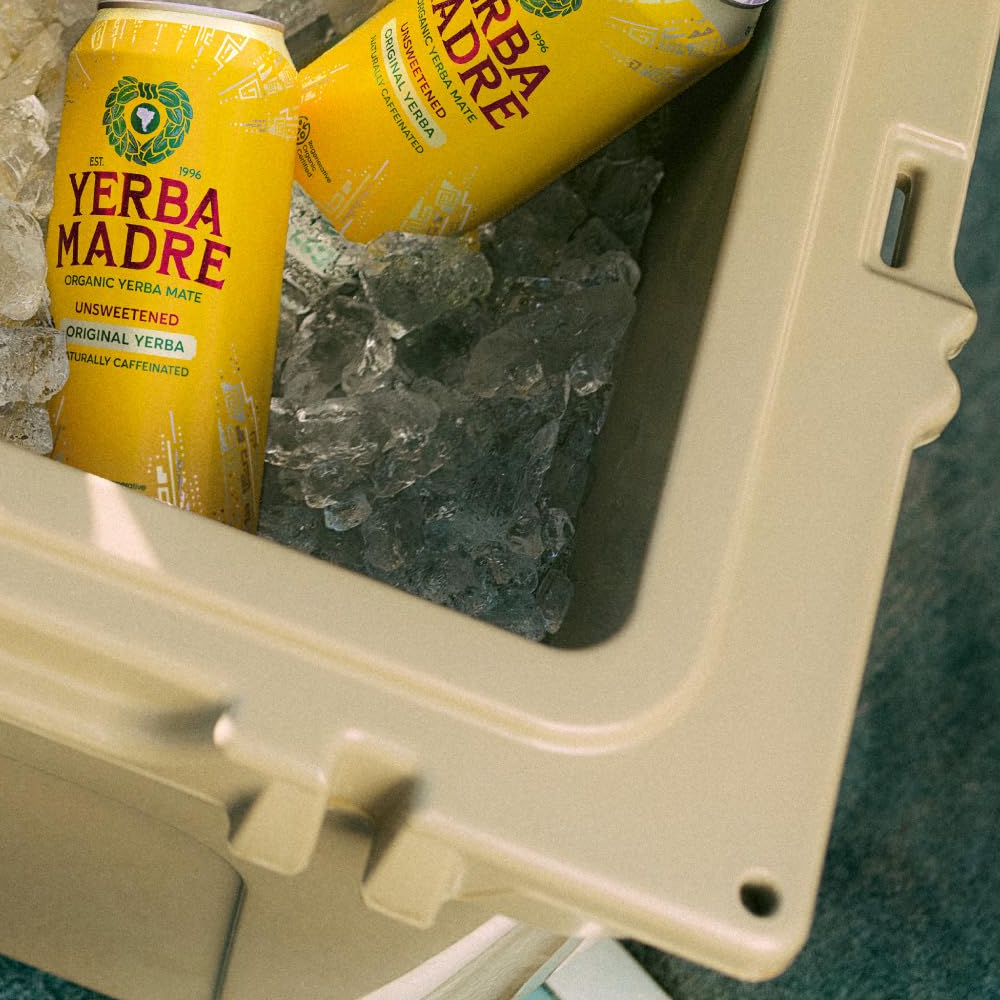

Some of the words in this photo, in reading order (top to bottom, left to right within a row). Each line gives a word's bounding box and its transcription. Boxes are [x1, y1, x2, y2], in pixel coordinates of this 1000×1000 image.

[530, 30, 549, 54] 1996
[384, 28, 407, 92] ORIGINAL
[403, 91, 436, 139] YERBA
[400, 21, 447, 119] UNSWEETENED
[429, 46, 453, 90] YERBA
[450, 89, 478, 124] MATE
[381, 87, 425, 154] CAFFEINATED
[89, 156, 104, 167] EST.
[179, 166, 202, 180] 1996
[69, 170, 222, 237] YERBA
[56, 221, 231, 290] MADRE
[64, 274, 115, 289] ORGANIC
[118, 278, 162, 295] YERBA
[165, 286, 203, 304] MATE
[75, 301, 180, 326] UNSWEETENED
[66, 326, 129, 345] ORIGINAL
[134, 334, 185, 353] YERBA
[66, 351, 111, 366] ATURALLY
[113, 358, 190, 377] CAFFEINATED
